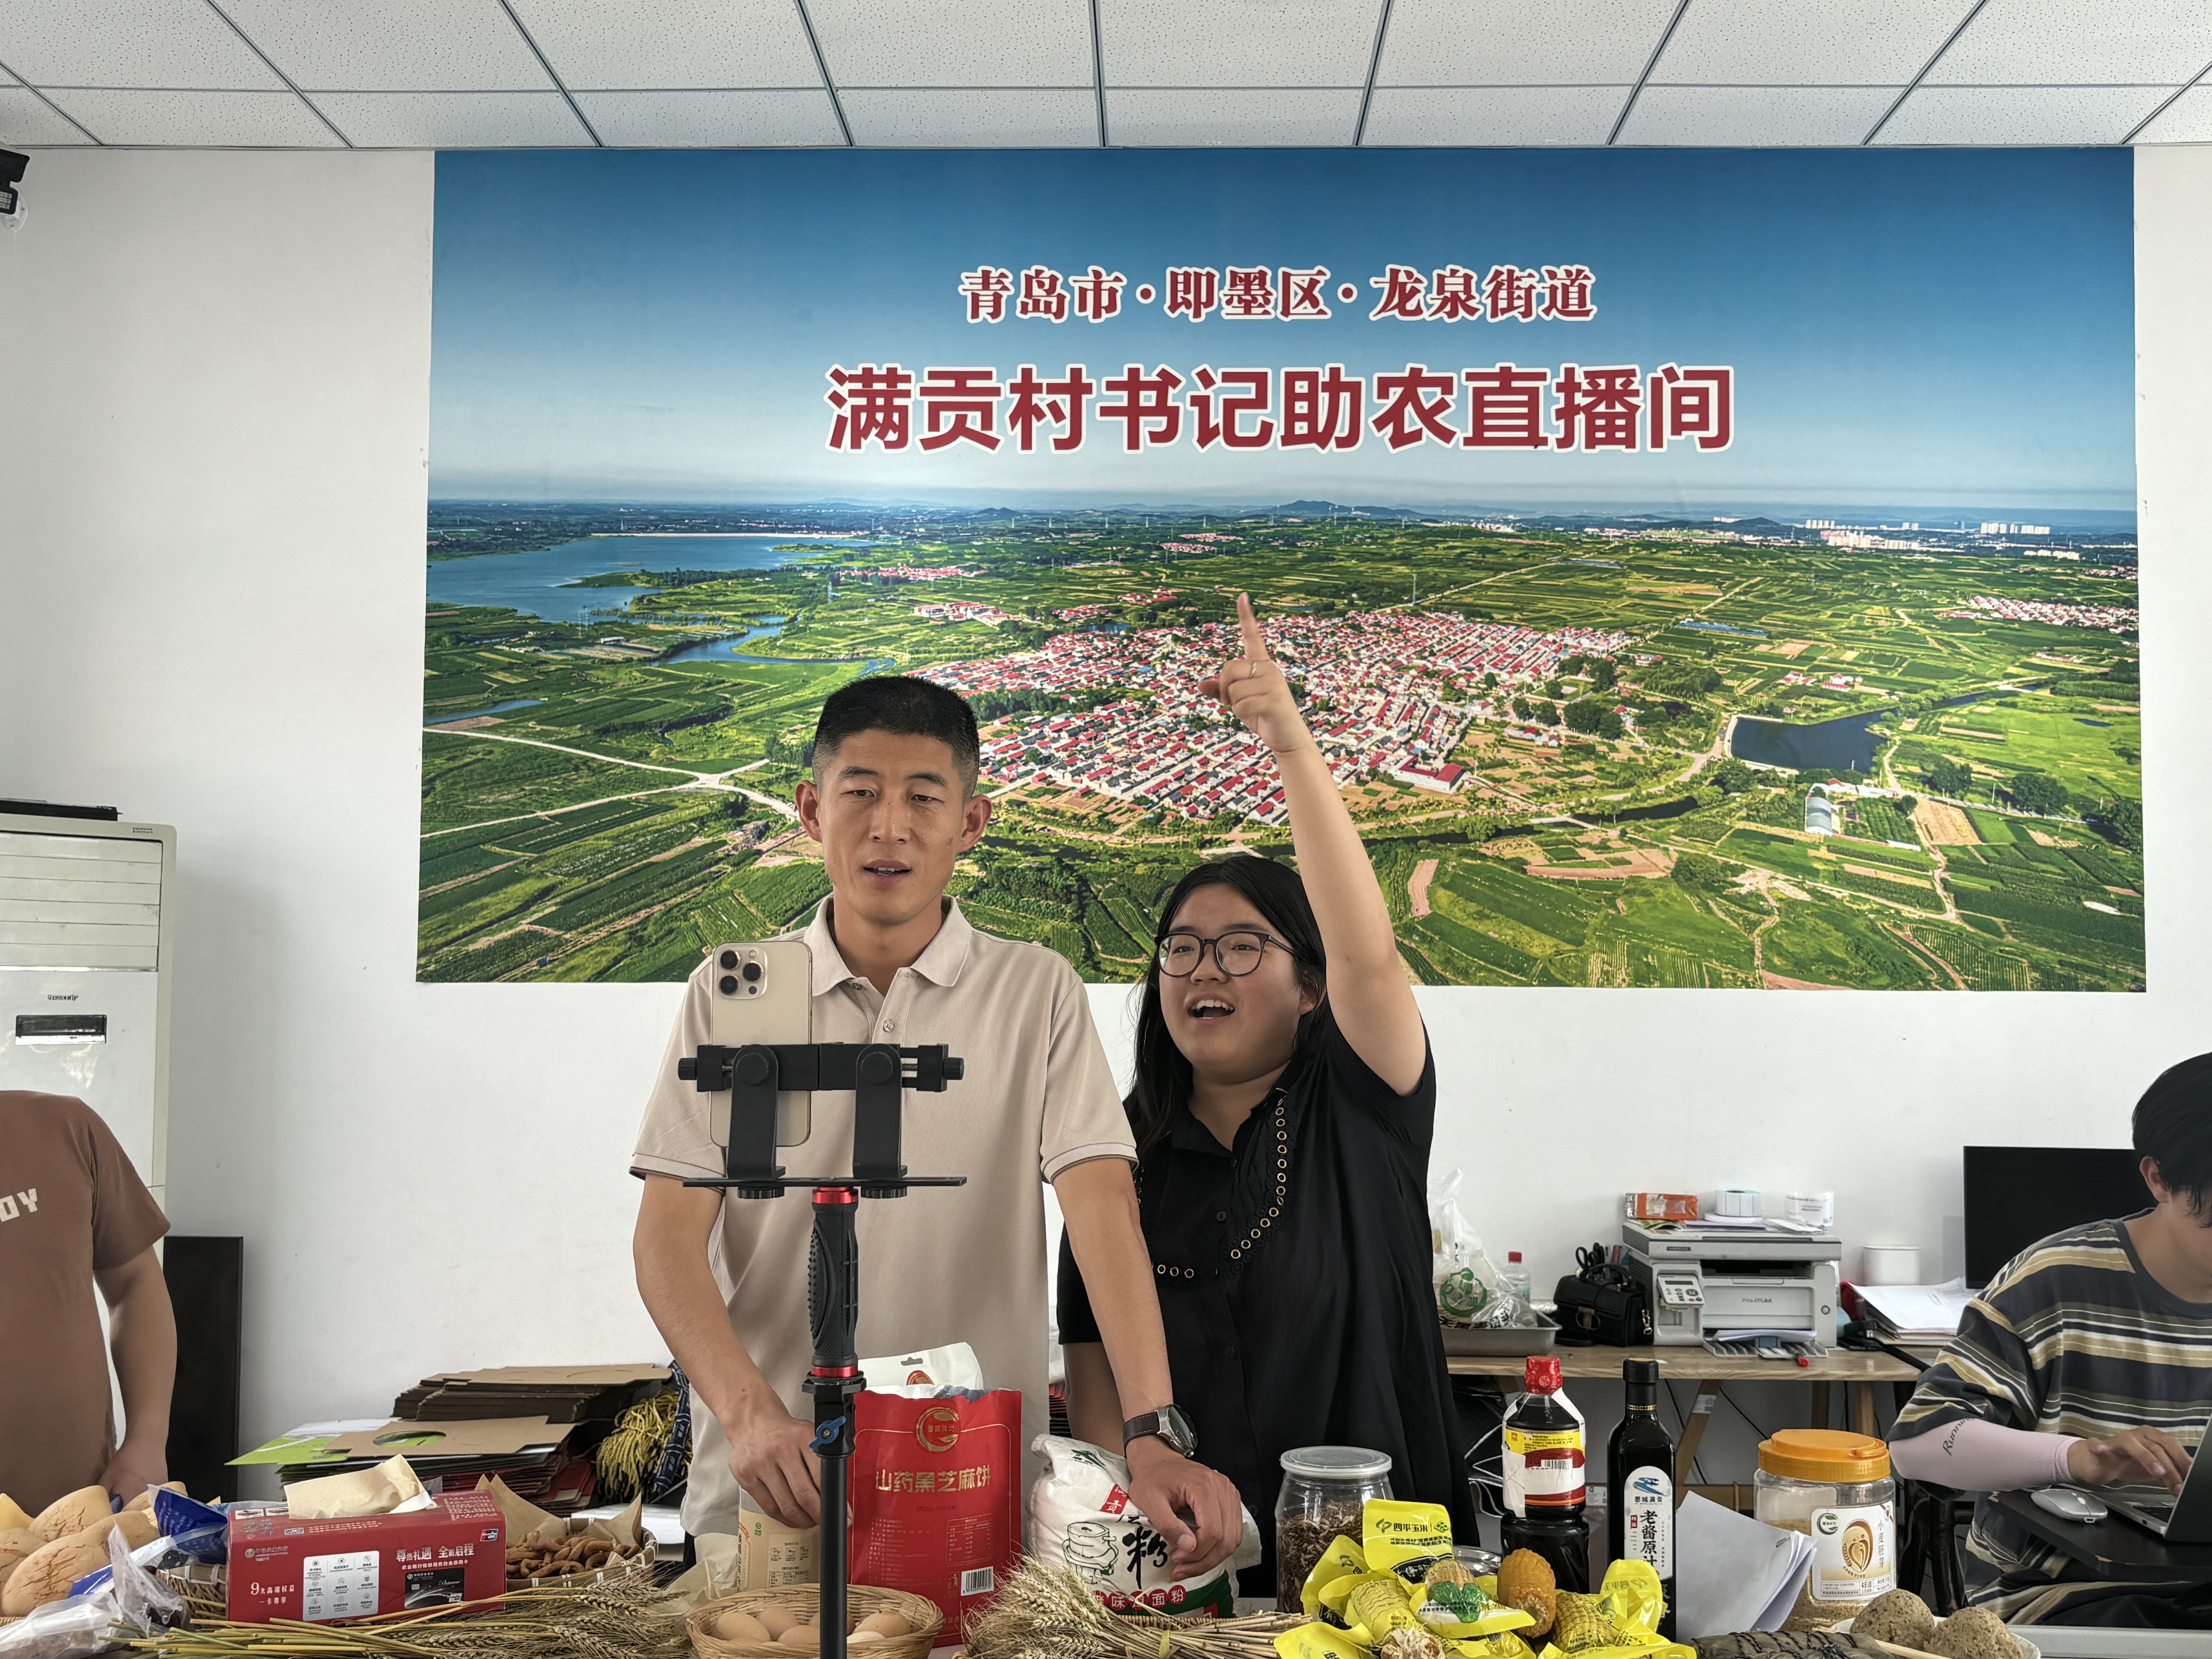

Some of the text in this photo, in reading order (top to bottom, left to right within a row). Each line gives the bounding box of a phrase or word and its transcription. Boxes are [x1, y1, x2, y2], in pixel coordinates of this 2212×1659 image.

[960, 266, 1596, 322] 青岛市·即墨区·龙泉街道
[827, 364, 1733, 452] 满贡村书记助农直播间
[875, 1464, 991, 1492] 山药黑芝麻饼
